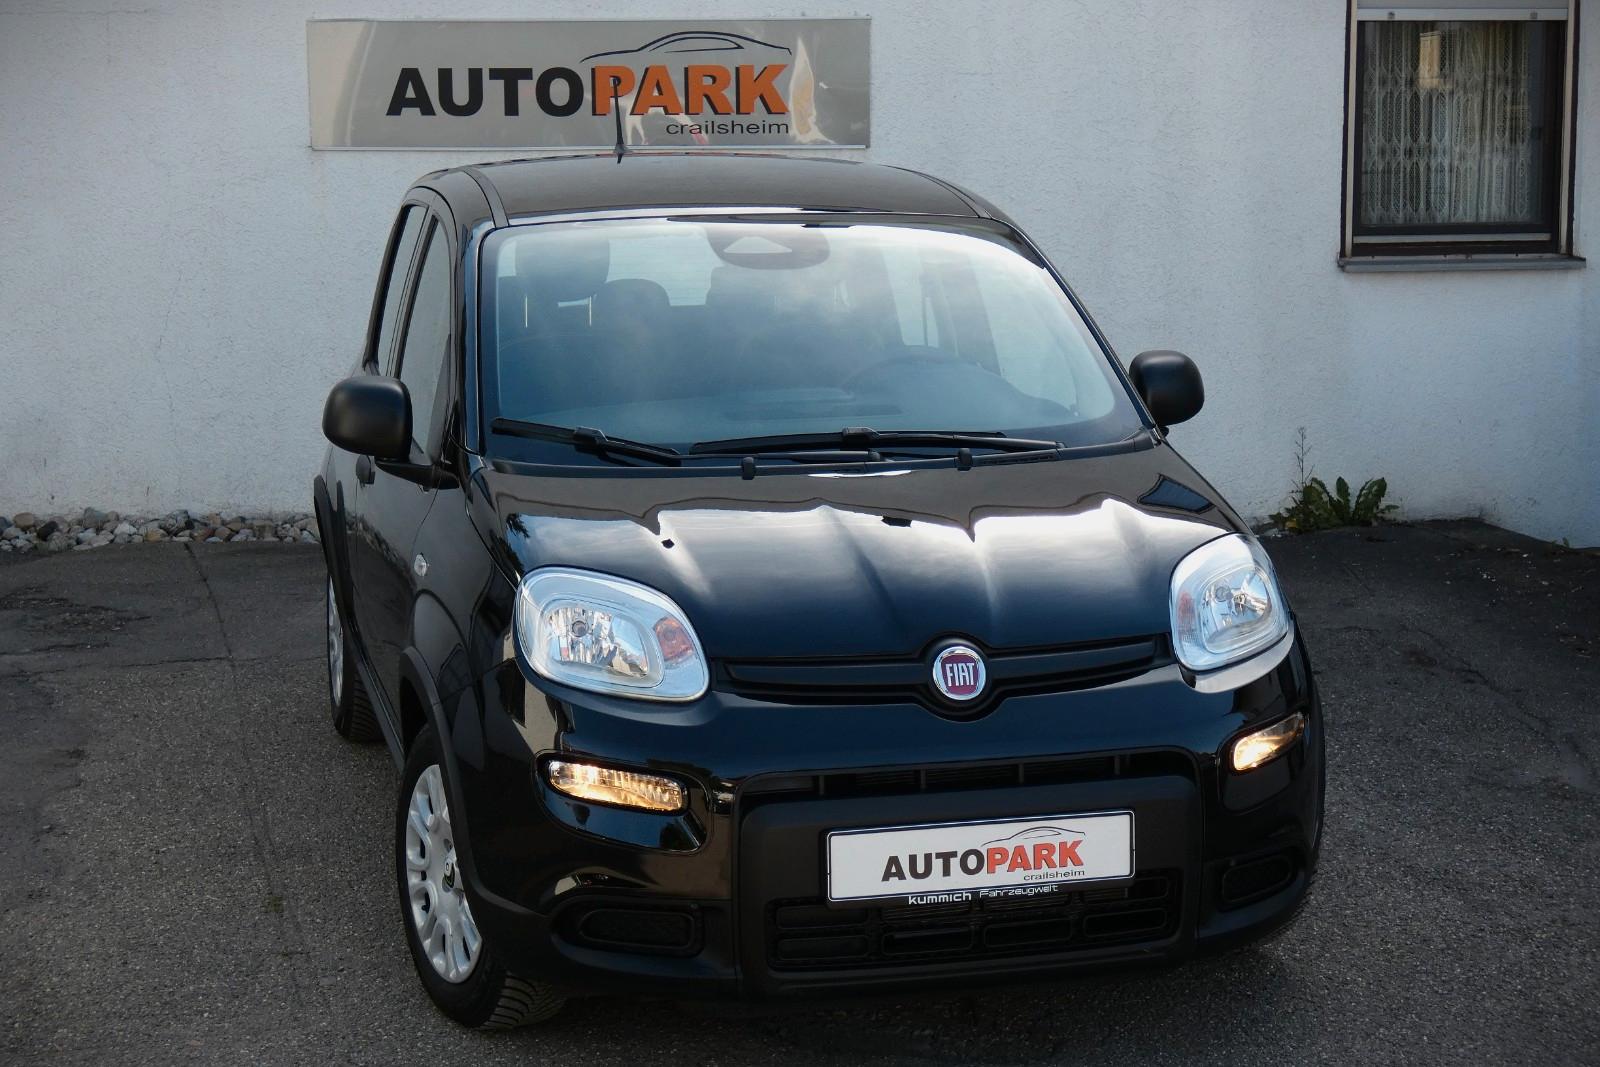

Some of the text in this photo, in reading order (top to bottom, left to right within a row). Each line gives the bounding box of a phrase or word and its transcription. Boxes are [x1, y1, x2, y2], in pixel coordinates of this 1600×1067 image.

[386, 64, 788, 117] AUTOPARK
[666, 120, 789, 135] crailsheim
[946, 663, 975, 686] FIAT
[881, 840, 1084, 882] AUTOPARK
[1023, 870, 1085, 881] crailsheim
